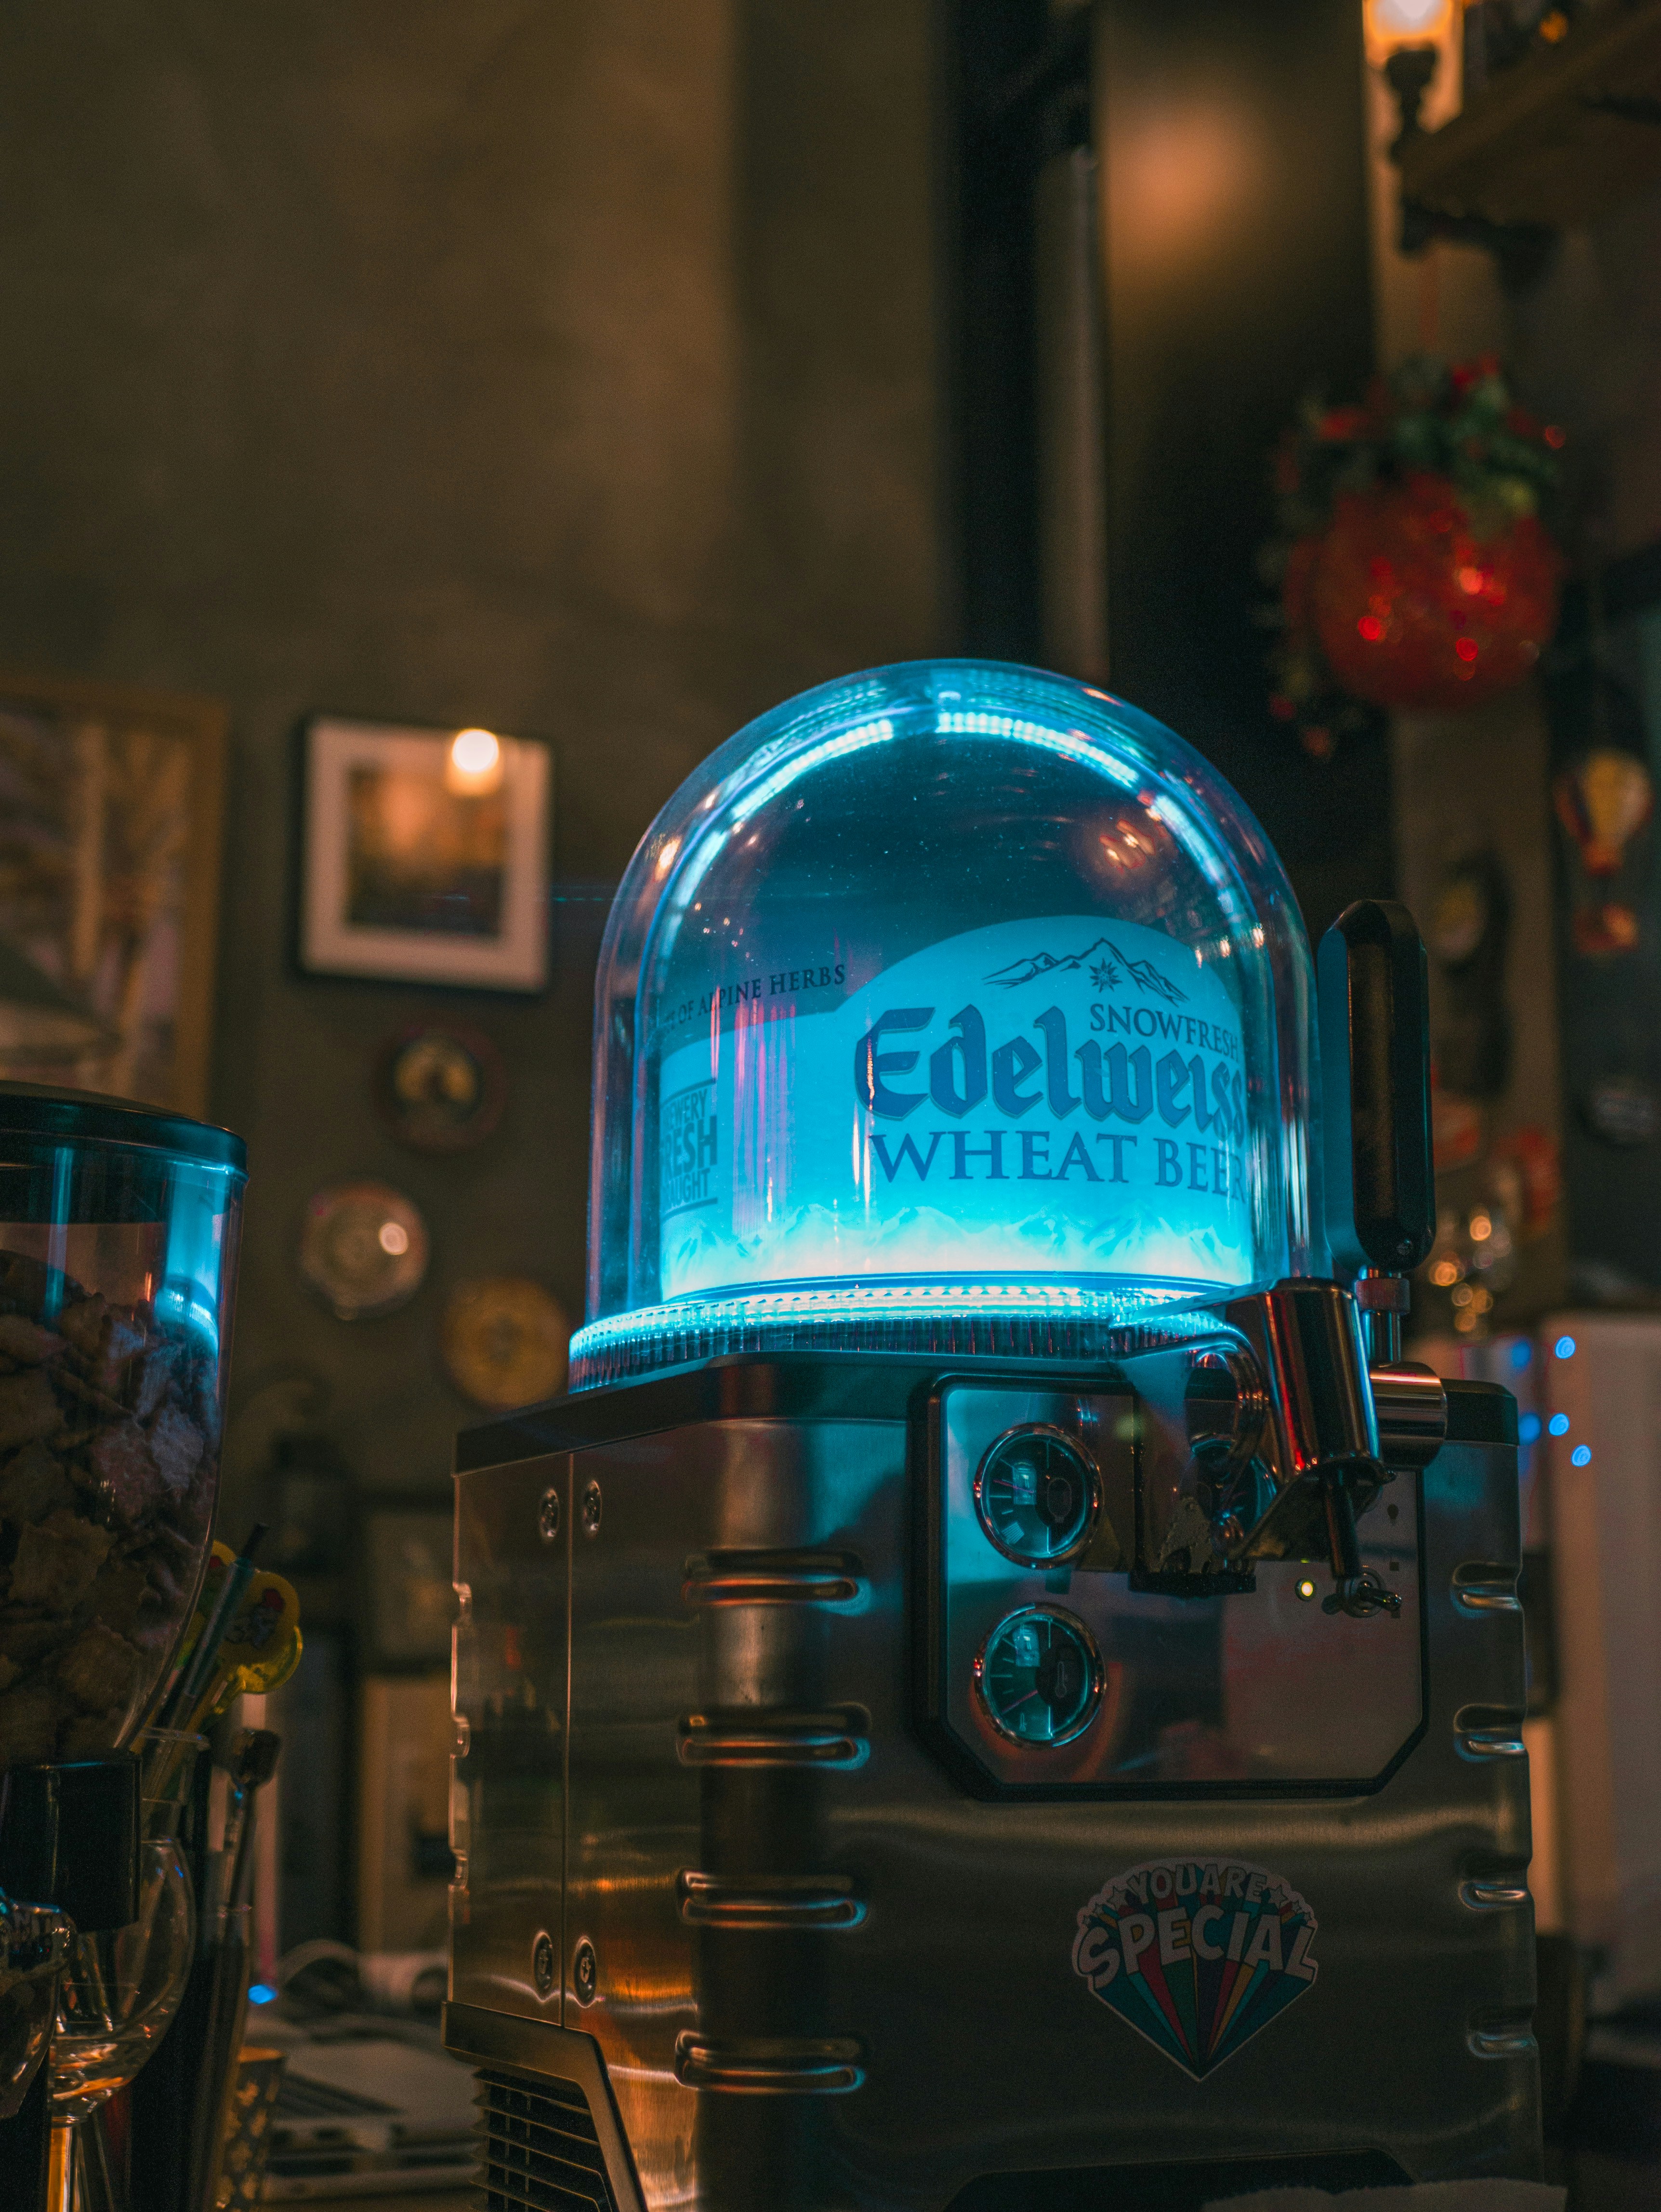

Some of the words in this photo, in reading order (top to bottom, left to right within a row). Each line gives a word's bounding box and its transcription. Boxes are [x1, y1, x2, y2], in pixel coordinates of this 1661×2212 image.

[678, 999, 694, 1025] OF
[770, 964, 845, 996] HERBS
[1090, 1003, 1239, 1063] SNOWFRESH
[854, 1004, 1246, 1148] Edelweiss
[867, 1130, 1137, 1184] WHEAT
[1153, 1138, 1246, 1203] BEER
[1126, 1863, 1198, 1905] YOU
[1199, 1863, 1267, 1904] ARE
[1077, 1904, 1317, 1990] SPECIAL
